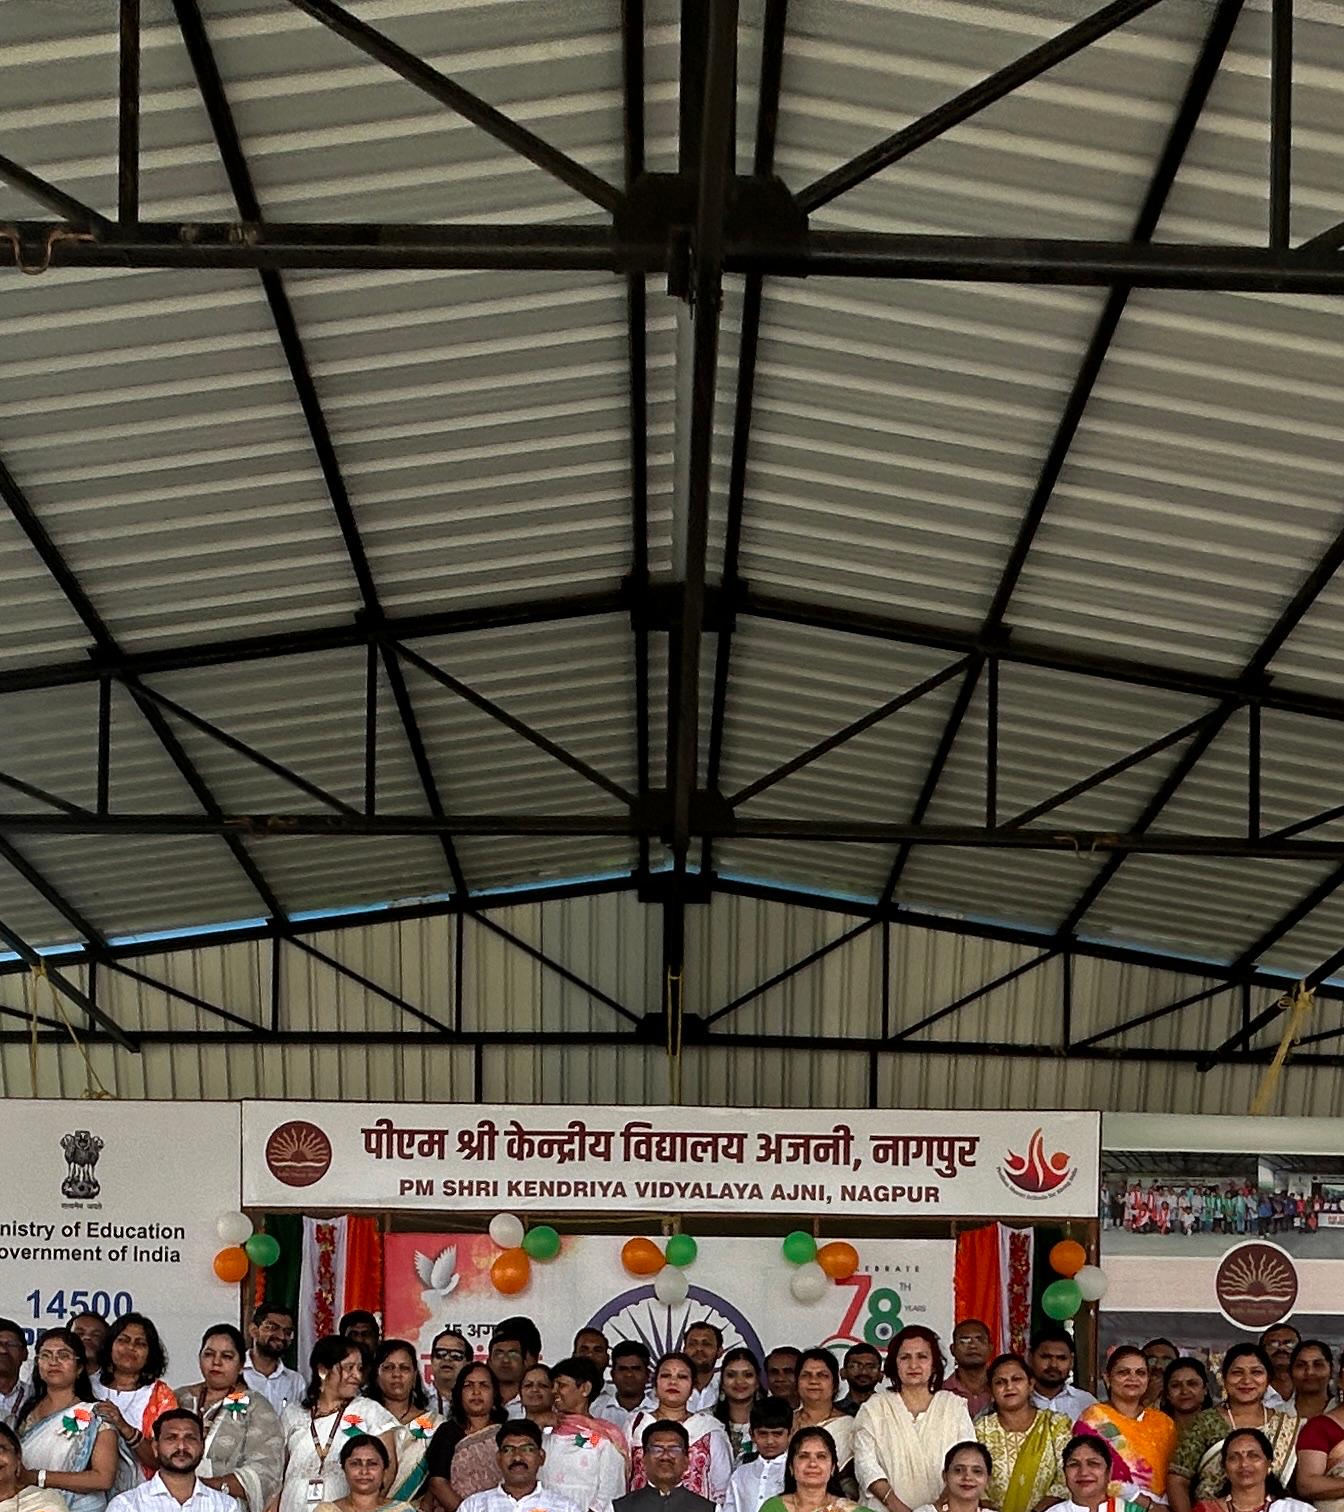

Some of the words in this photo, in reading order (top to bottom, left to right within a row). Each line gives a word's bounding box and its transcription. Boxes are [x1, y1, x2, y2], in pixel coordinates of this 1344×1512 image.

[361, 1118, 449, 1160] पीएम
[456, 1119, 499, 1161] श्री
[504, 1120, 615, 1164] केन्द्रीय
[620, 1121, 748, 1163] विद्यालय
[756, 1124, 861, 1171] अजनी,
[869, 1135, 981, 1178] नागपुर
[399, 1179, 434, 1197] PM
[443, 1179, 499, 1197] SHRI
[508, 1180, 628, 1198] KENDRIYA
[635, 1181, 764, 1200] VIDYALAYA
[771, 1184, 833, 1205] AJNI,
[841, 1186, 940, 1203] NAGPUR
[61, 1221, 82, 1238] of
[87, 1222, 185, 1240] Education
[108, 1245, 129, 1262] of
[134, 1246, 181, 1263] India
[856, 1264, 919, 1273] EBRATE
[26, 1289, 133, 1320] 14500
[835, 1274, 905, 1348] 78
